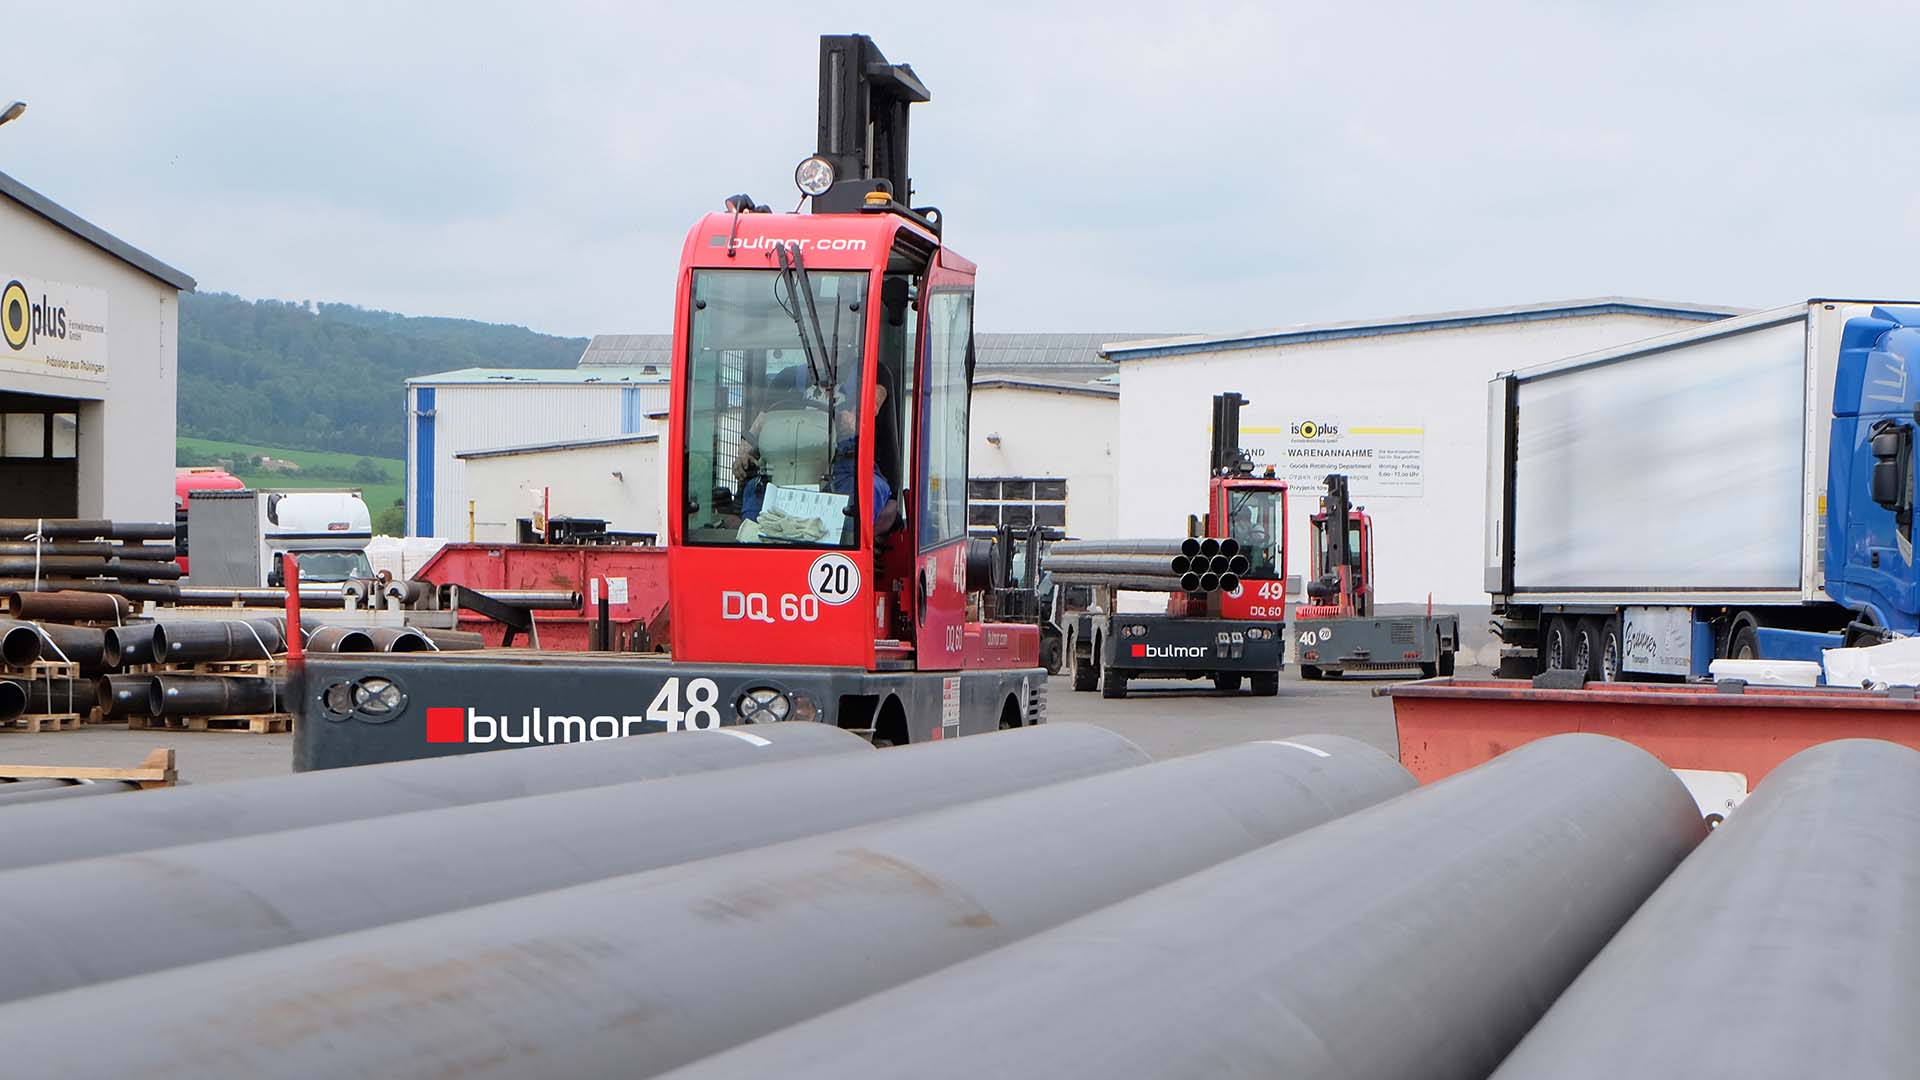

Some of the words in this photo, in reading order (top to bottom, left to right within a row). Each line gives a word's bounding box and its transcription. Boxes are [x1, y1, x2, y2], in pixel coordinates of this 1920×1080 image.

[1288, 449, 1373, 458] WARENANNAHME
[819, 563, 849, 595] 20
[1258, 582, 1283, 600] 49
[721, 590, 775, 623] DQ
[780, 593, 819, 622] 60
[1250, 606, 1267, 617] DQ
[1268, 607, 1282, 616] 60
[1299, 631, 1316, 646] 40
[1146, 643, 1208, 658] bulmor
[468, 707, 642, 744] bulmor
[646, 677, 721, 732] 48
